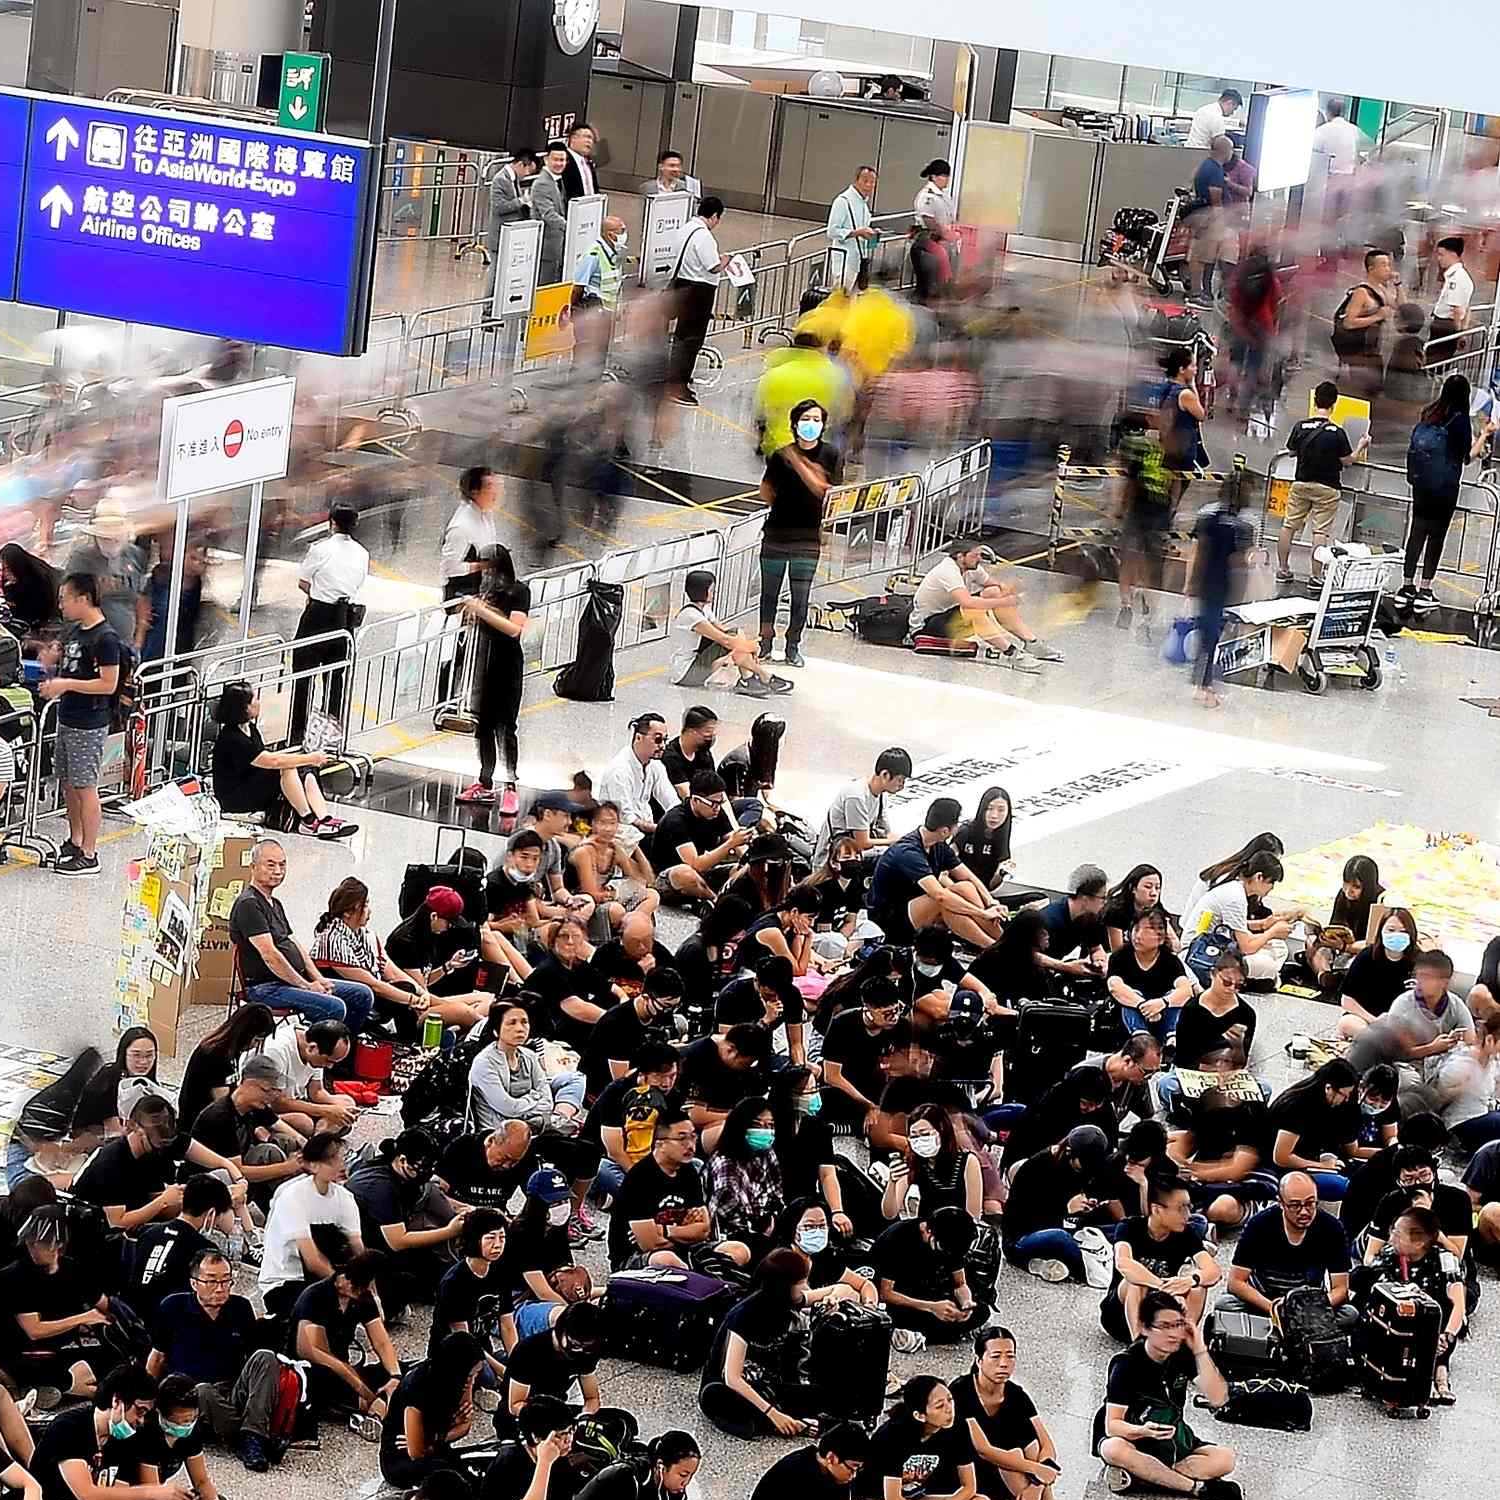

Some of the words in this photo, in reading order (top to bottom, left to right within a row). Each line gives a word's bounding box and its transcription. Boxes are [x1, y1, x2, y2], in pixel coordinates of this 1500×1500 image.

[132, 153, 153, 175] To
[155, 157, 297, 197] AsiaWorld-Expo
[134, 124, 355, 183] 往亞洲國際博覽館
[80, 215, 138, 242] Airline
[141, 223, 202, 251] Offices
[82, 186, 276, 240] 航空公司辦公室
[246, 428, 257, 441] No
